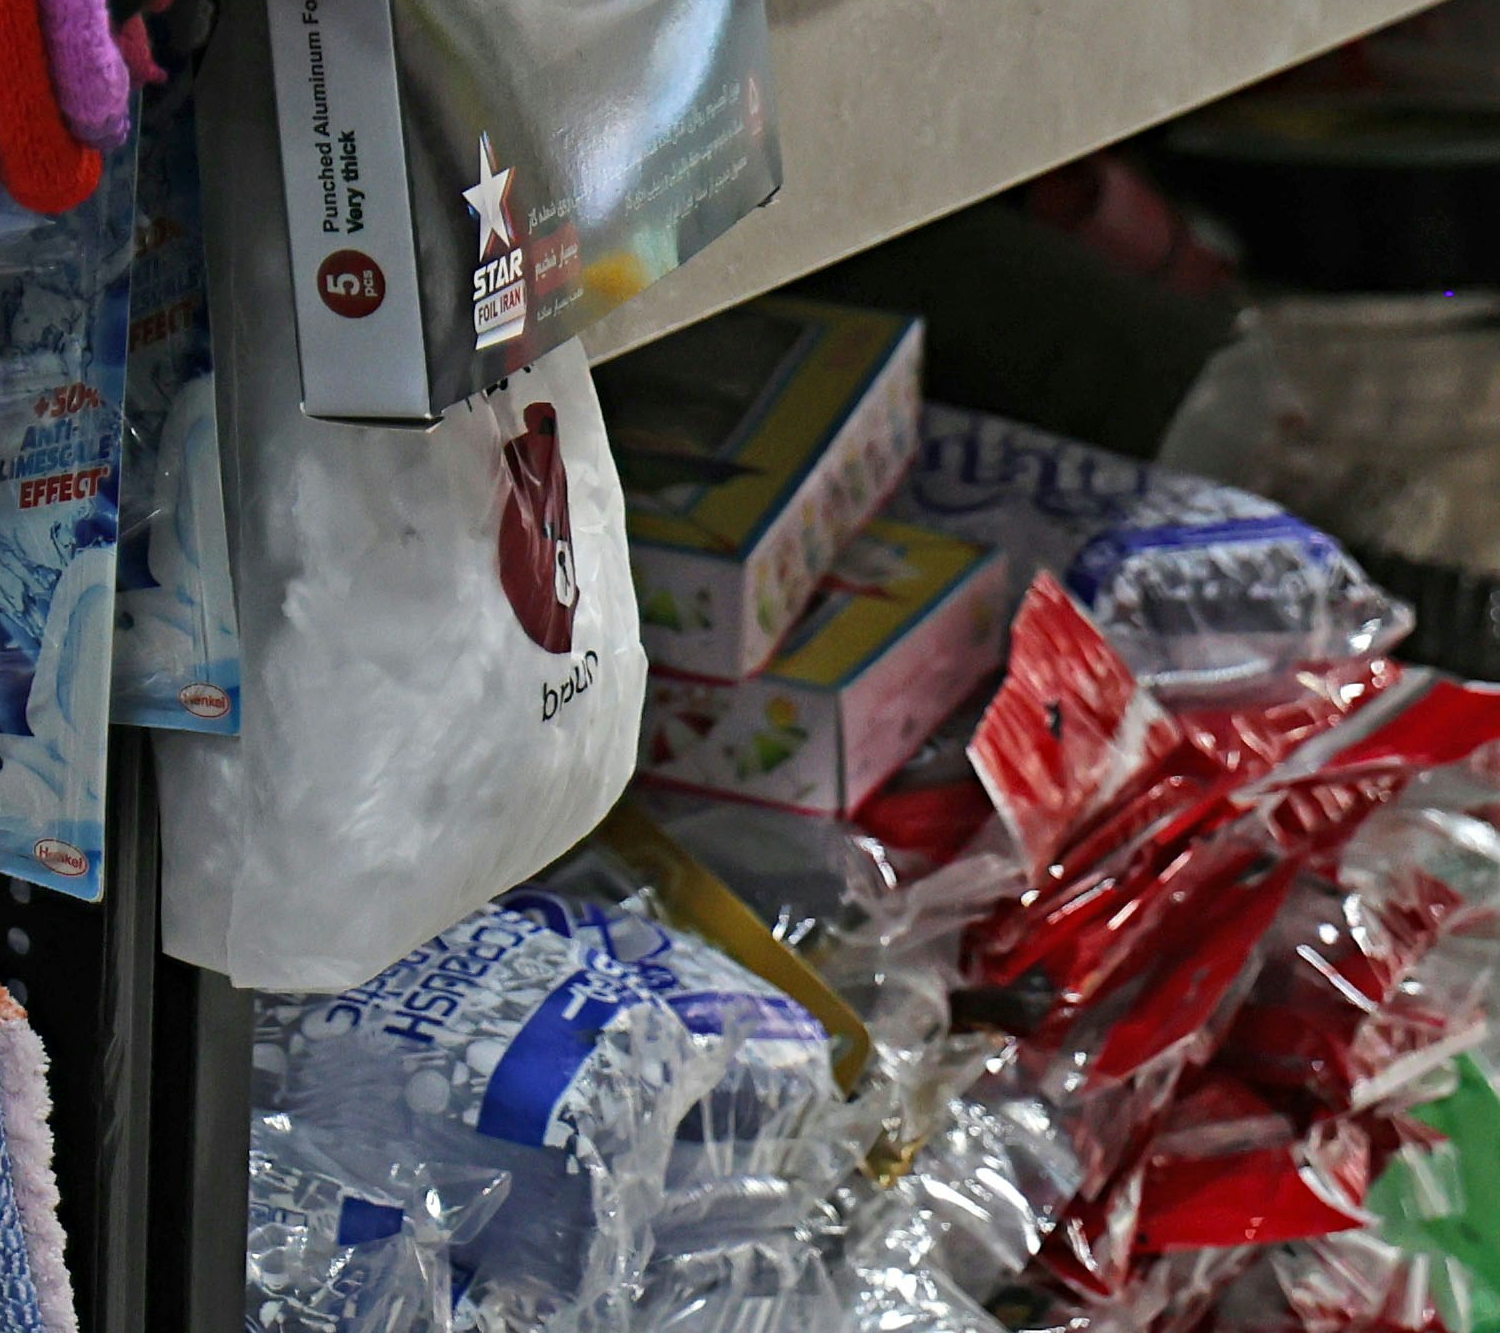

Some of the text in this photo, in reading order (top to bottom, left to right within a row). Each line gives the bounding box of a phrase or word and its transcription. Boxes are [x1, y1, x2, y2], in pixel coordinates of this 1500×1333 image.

[305, 31, 331, 138] Aluminum
[314, 141, 342, 234] Punched
[337, 129, 369, 236] Very thick
[323, 272, 362, 298] 5
[362, 269, 379, 298] pcs
[473, 247, 523, 302] STAR
[478, 288, 522, 325] FOIL IRAN
